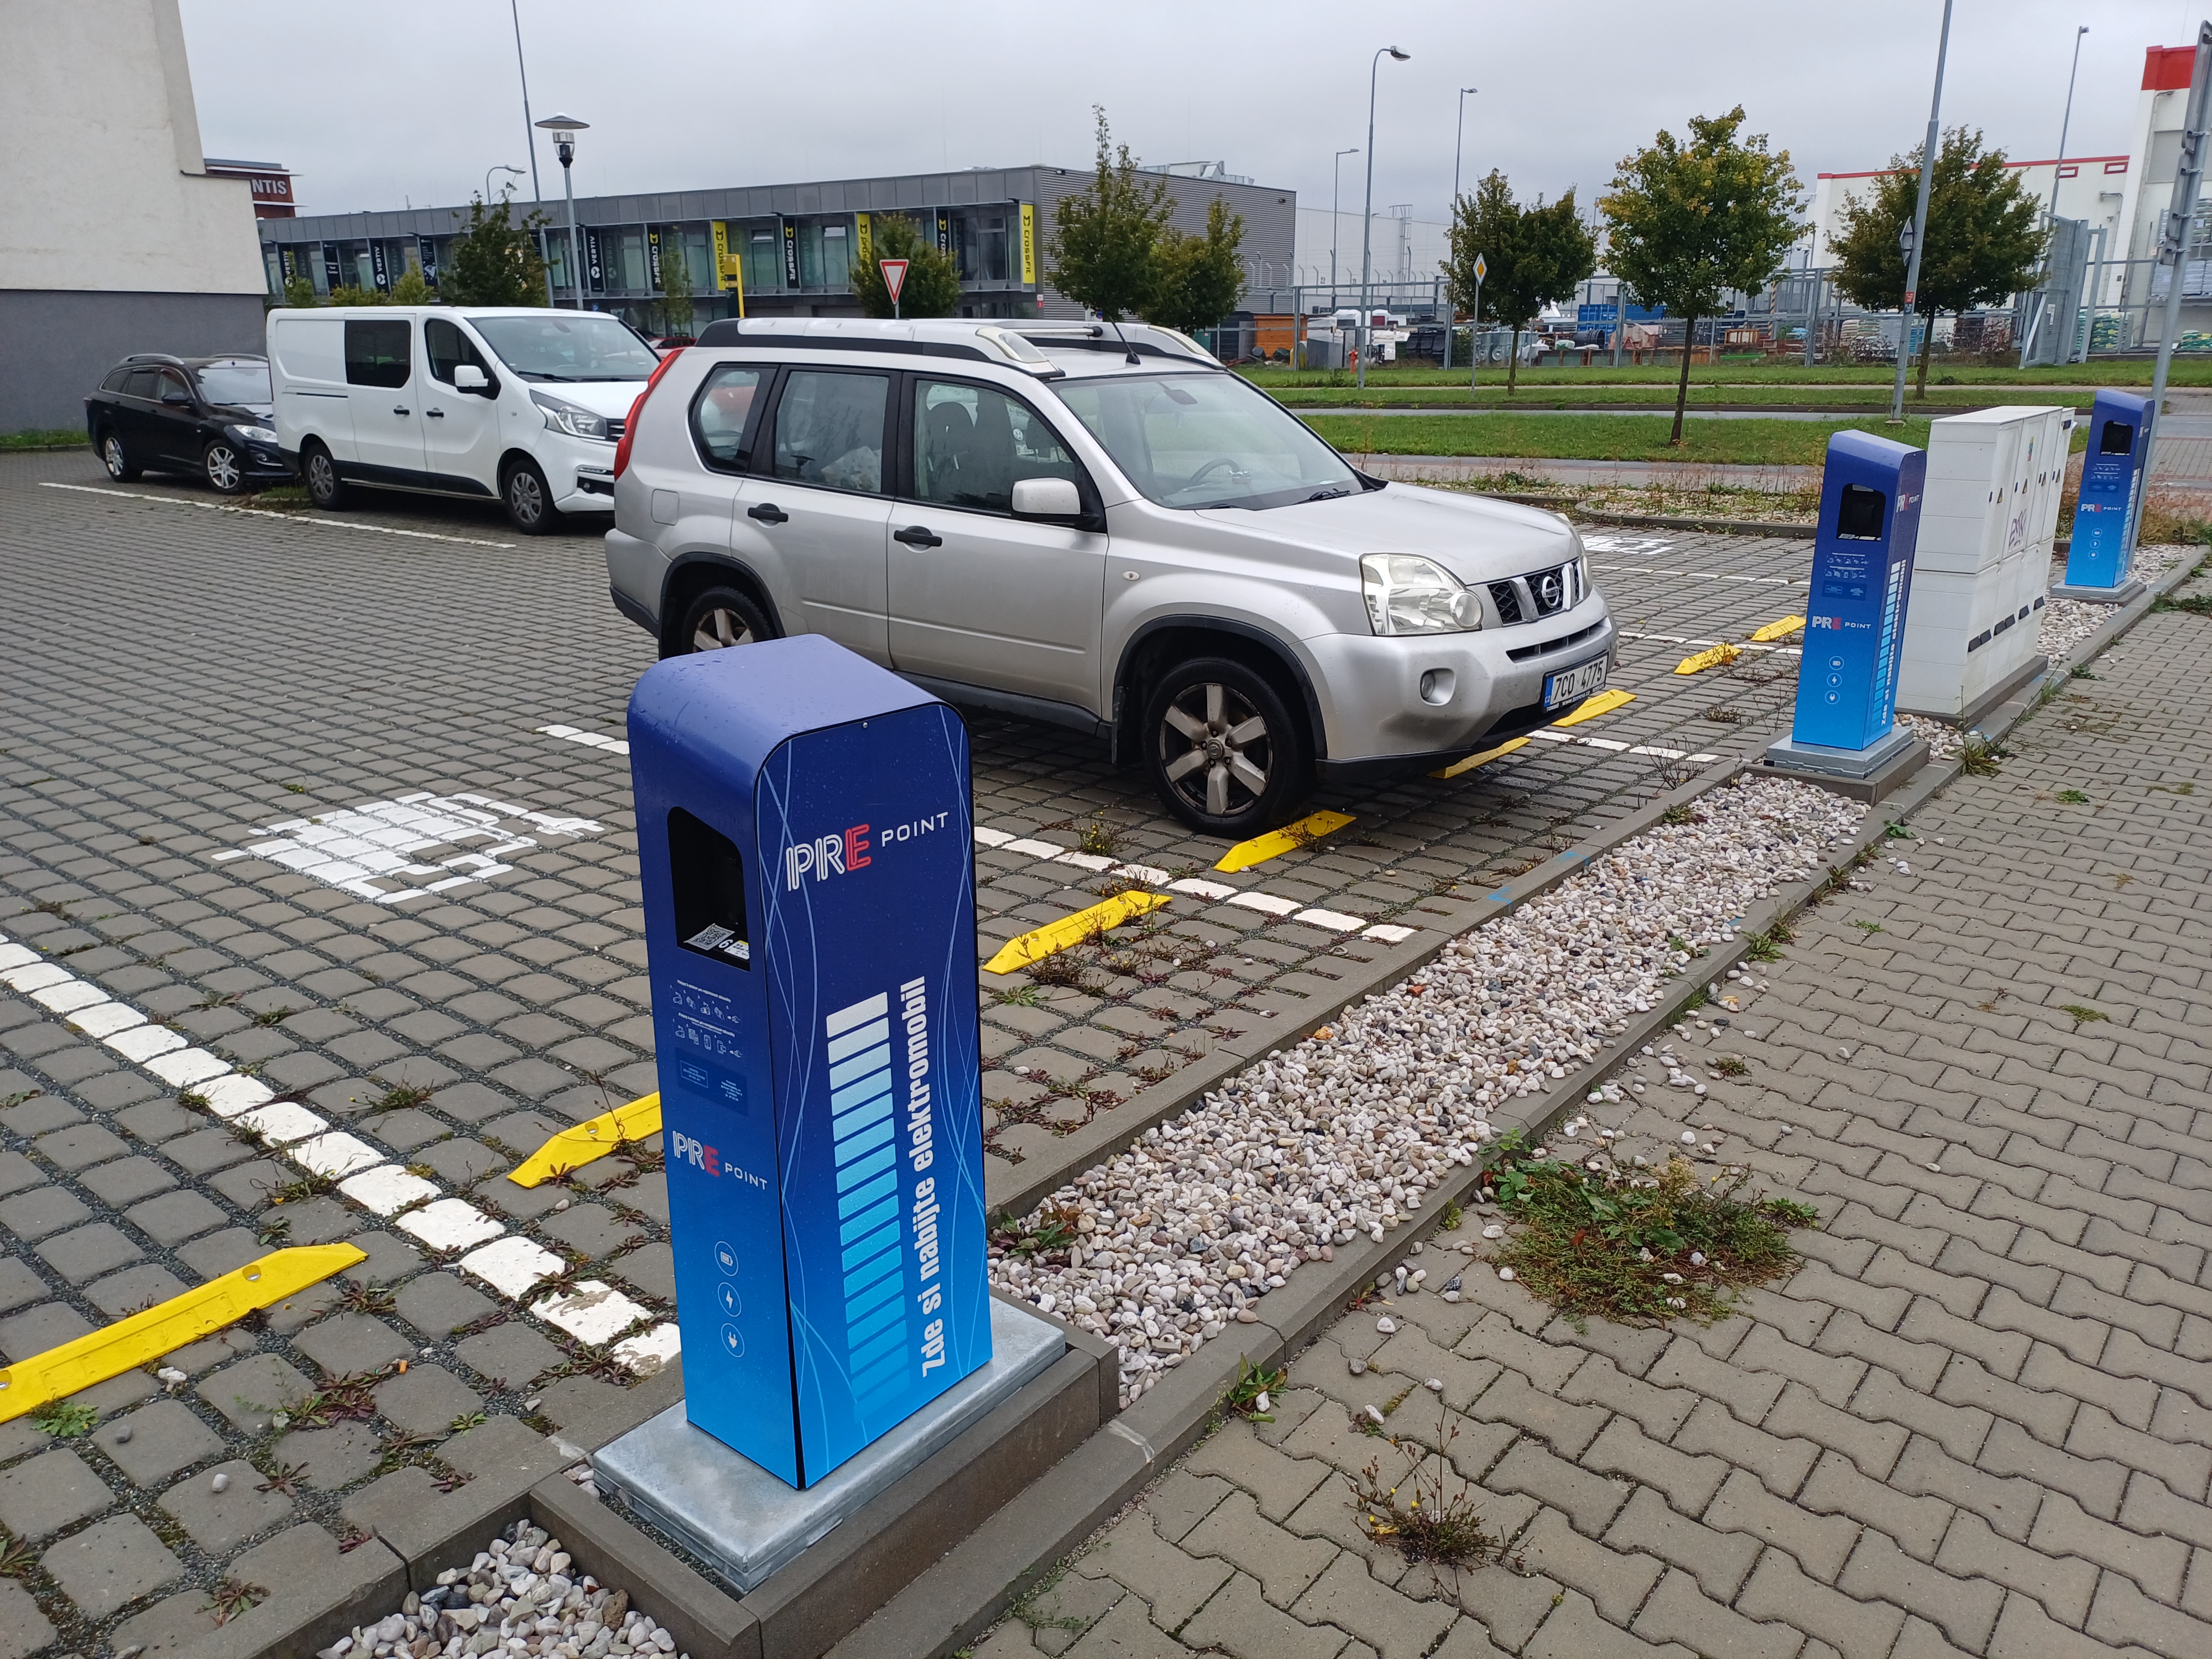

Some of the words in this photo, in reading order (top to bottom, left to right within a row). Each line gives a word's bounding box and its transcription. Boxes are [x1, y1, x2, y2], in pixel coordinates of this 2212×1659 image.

[1545, 695, 1551, 703] CZ
[1581, 660, 1604, 689] 4775
[786, 824, 872, 891] PRE
[881, 812, 948, 847] POINT
[900, 976, 934, 1172] elektromobil
[672, 1130, 721, 1177] PRE
[725, 1162, 768, 1190] POINT
[912, 1177, 940, 1282] nabijte
[917, 1282, 942, 1315] si
[922, 1318, 946, 1378] Zde
